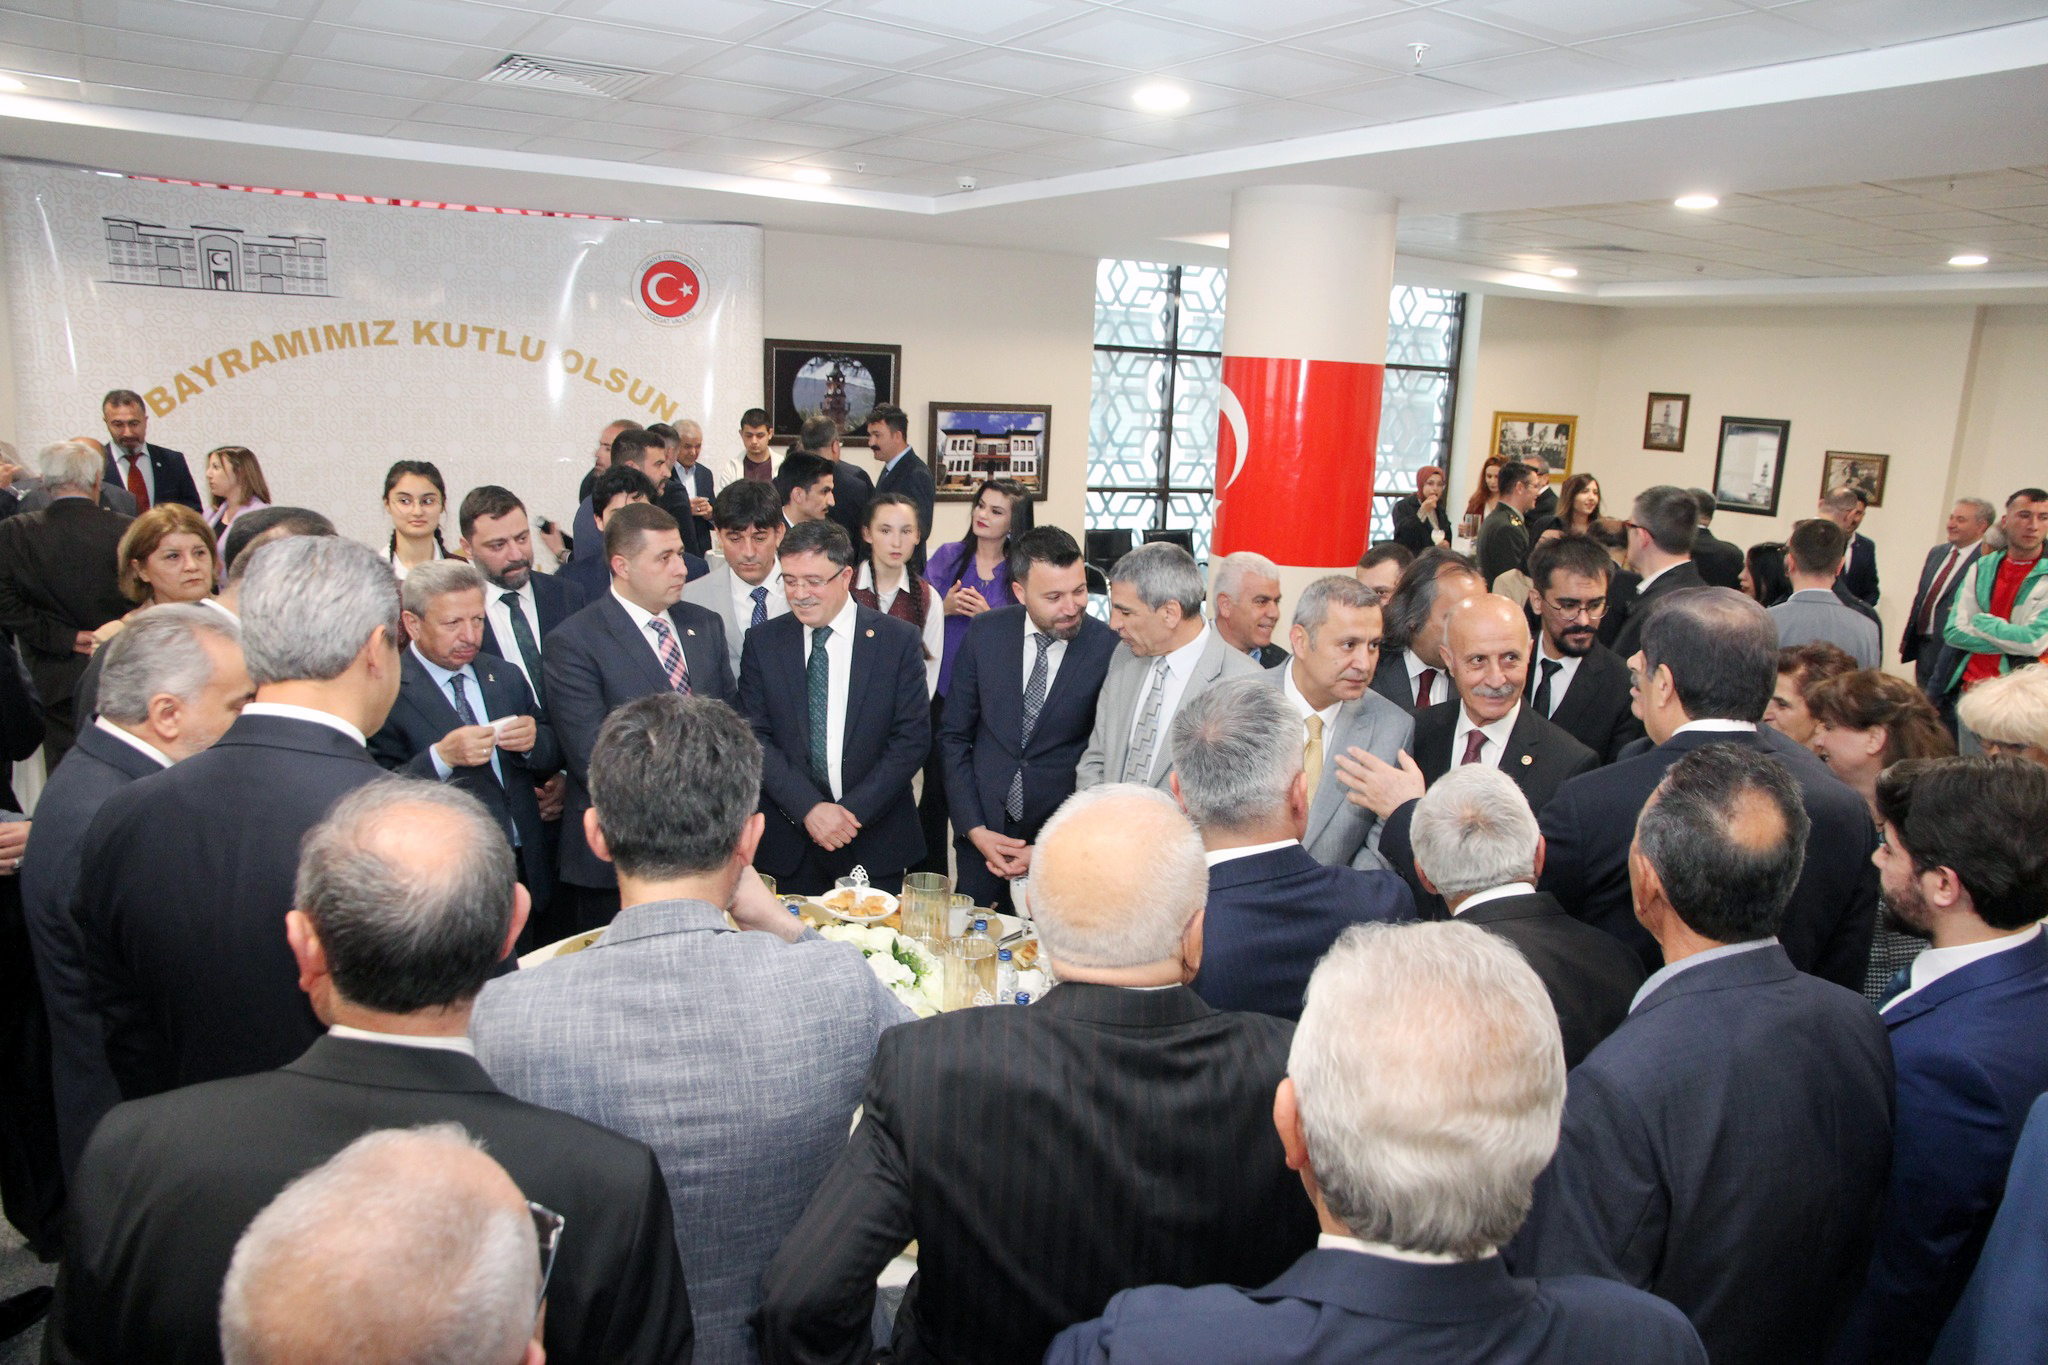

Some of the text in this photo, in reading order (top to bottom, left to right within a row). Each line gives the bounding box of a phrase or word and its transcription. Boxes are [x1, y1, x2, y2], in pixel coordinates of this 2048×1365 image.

[143, 319, 680, 423] BAYRAMIMIZ KUTLU OLSUN
